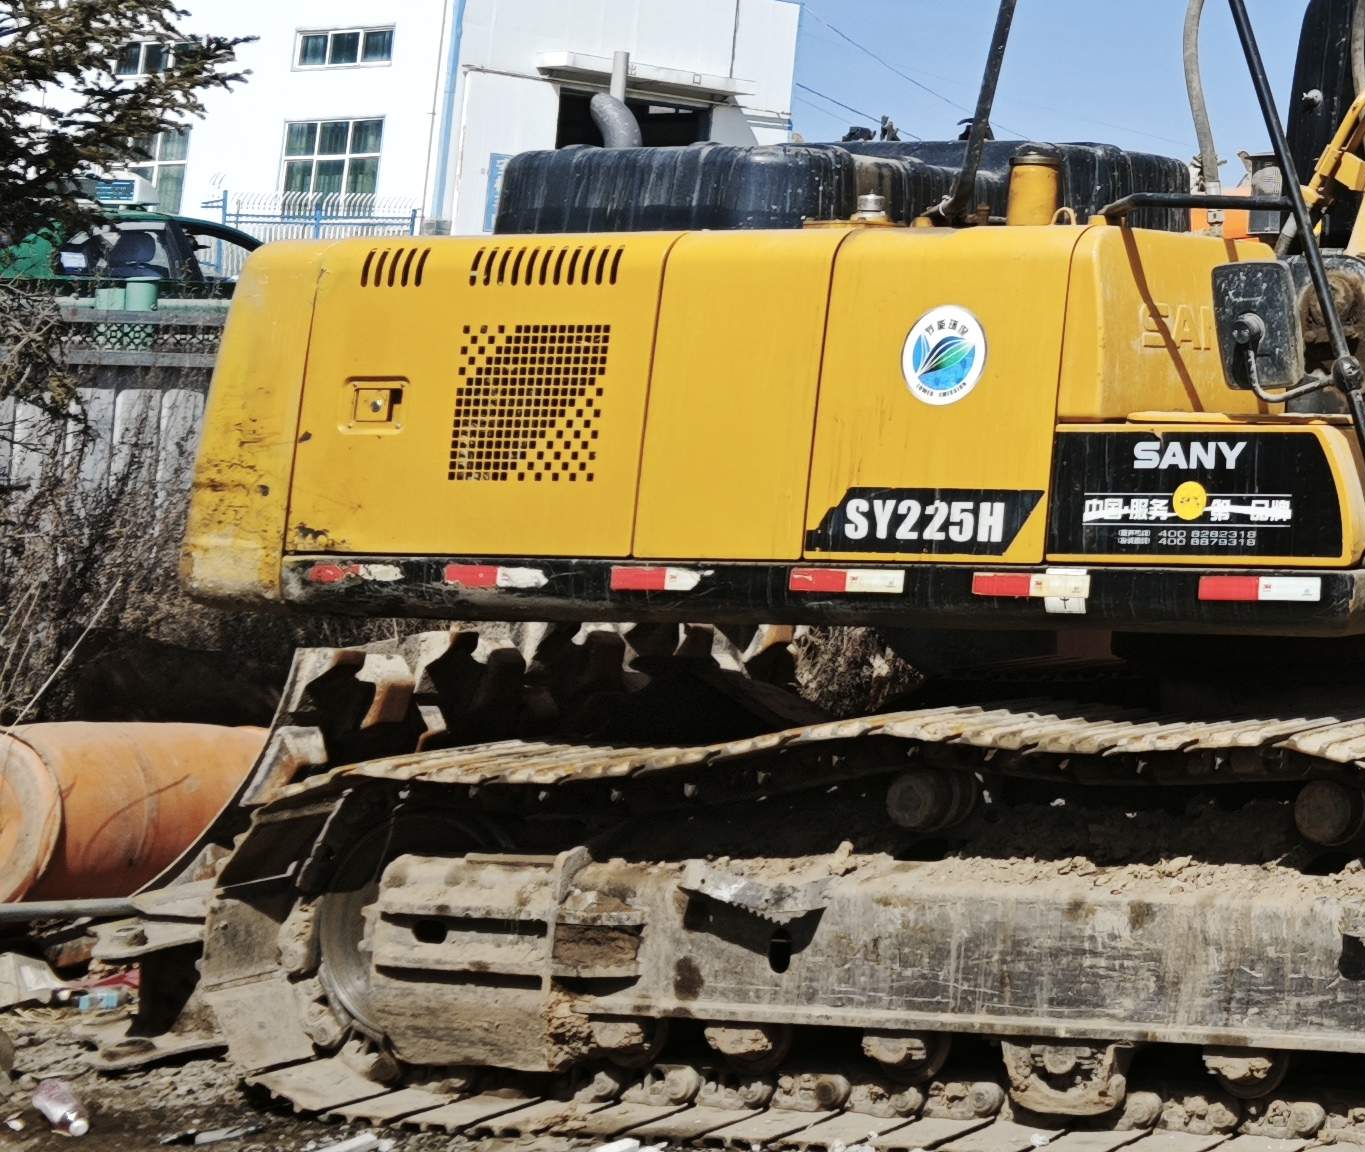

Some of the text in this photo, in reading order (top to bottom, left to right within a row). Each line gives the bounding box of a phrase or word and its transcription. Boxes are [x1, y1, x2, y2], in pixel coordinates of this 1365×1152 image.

[1133, 441, 1247, 470] SANY
[844, 498, 1006, 543] SY225H
[1158, 529, 1187, 538] 400
[1158, 538, 1186, 546] 400
